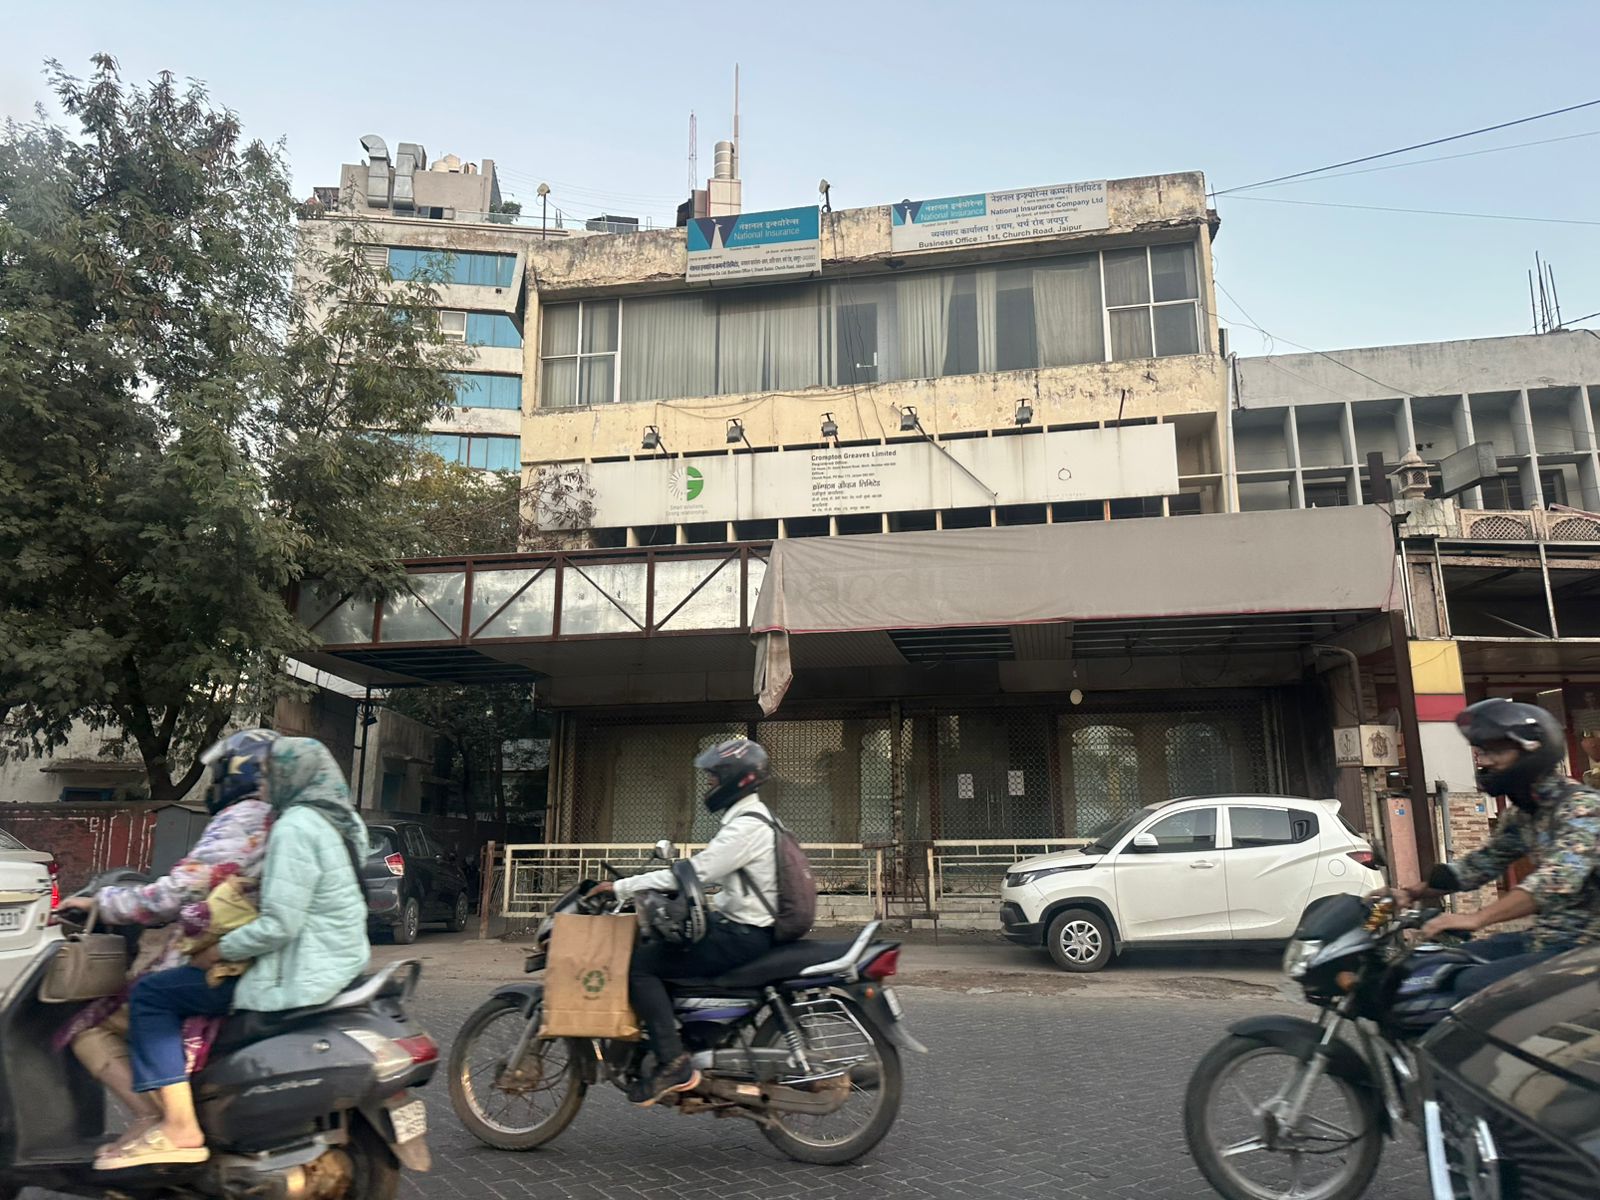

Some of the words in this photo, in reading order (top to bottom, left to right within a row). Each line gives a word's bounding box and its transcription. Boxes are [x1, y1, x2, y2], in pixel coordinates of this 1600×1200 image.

[1075, 182, 1102, 193] लिमिटेड
[990, 207, 1019, 216] National
[1020, 203, 1055, 212] Insurance
[1056, 199, 1090, 209] Company
[920, 211, 947, 221] National
[950, 208, 984, 218] Insurance
[734, 231, 762, 240] National
[765, 228, 800, 236] Insurance
[918, 240, 954, 248] Business
[955, 236, 978, 244] Office
[1002, 230, 1031, 239] Church
[1032, 227, 1055, 236] Road,
[1057, 224, 1082, 233] Jaipur
[811, 454, 842, 462] Crompton
